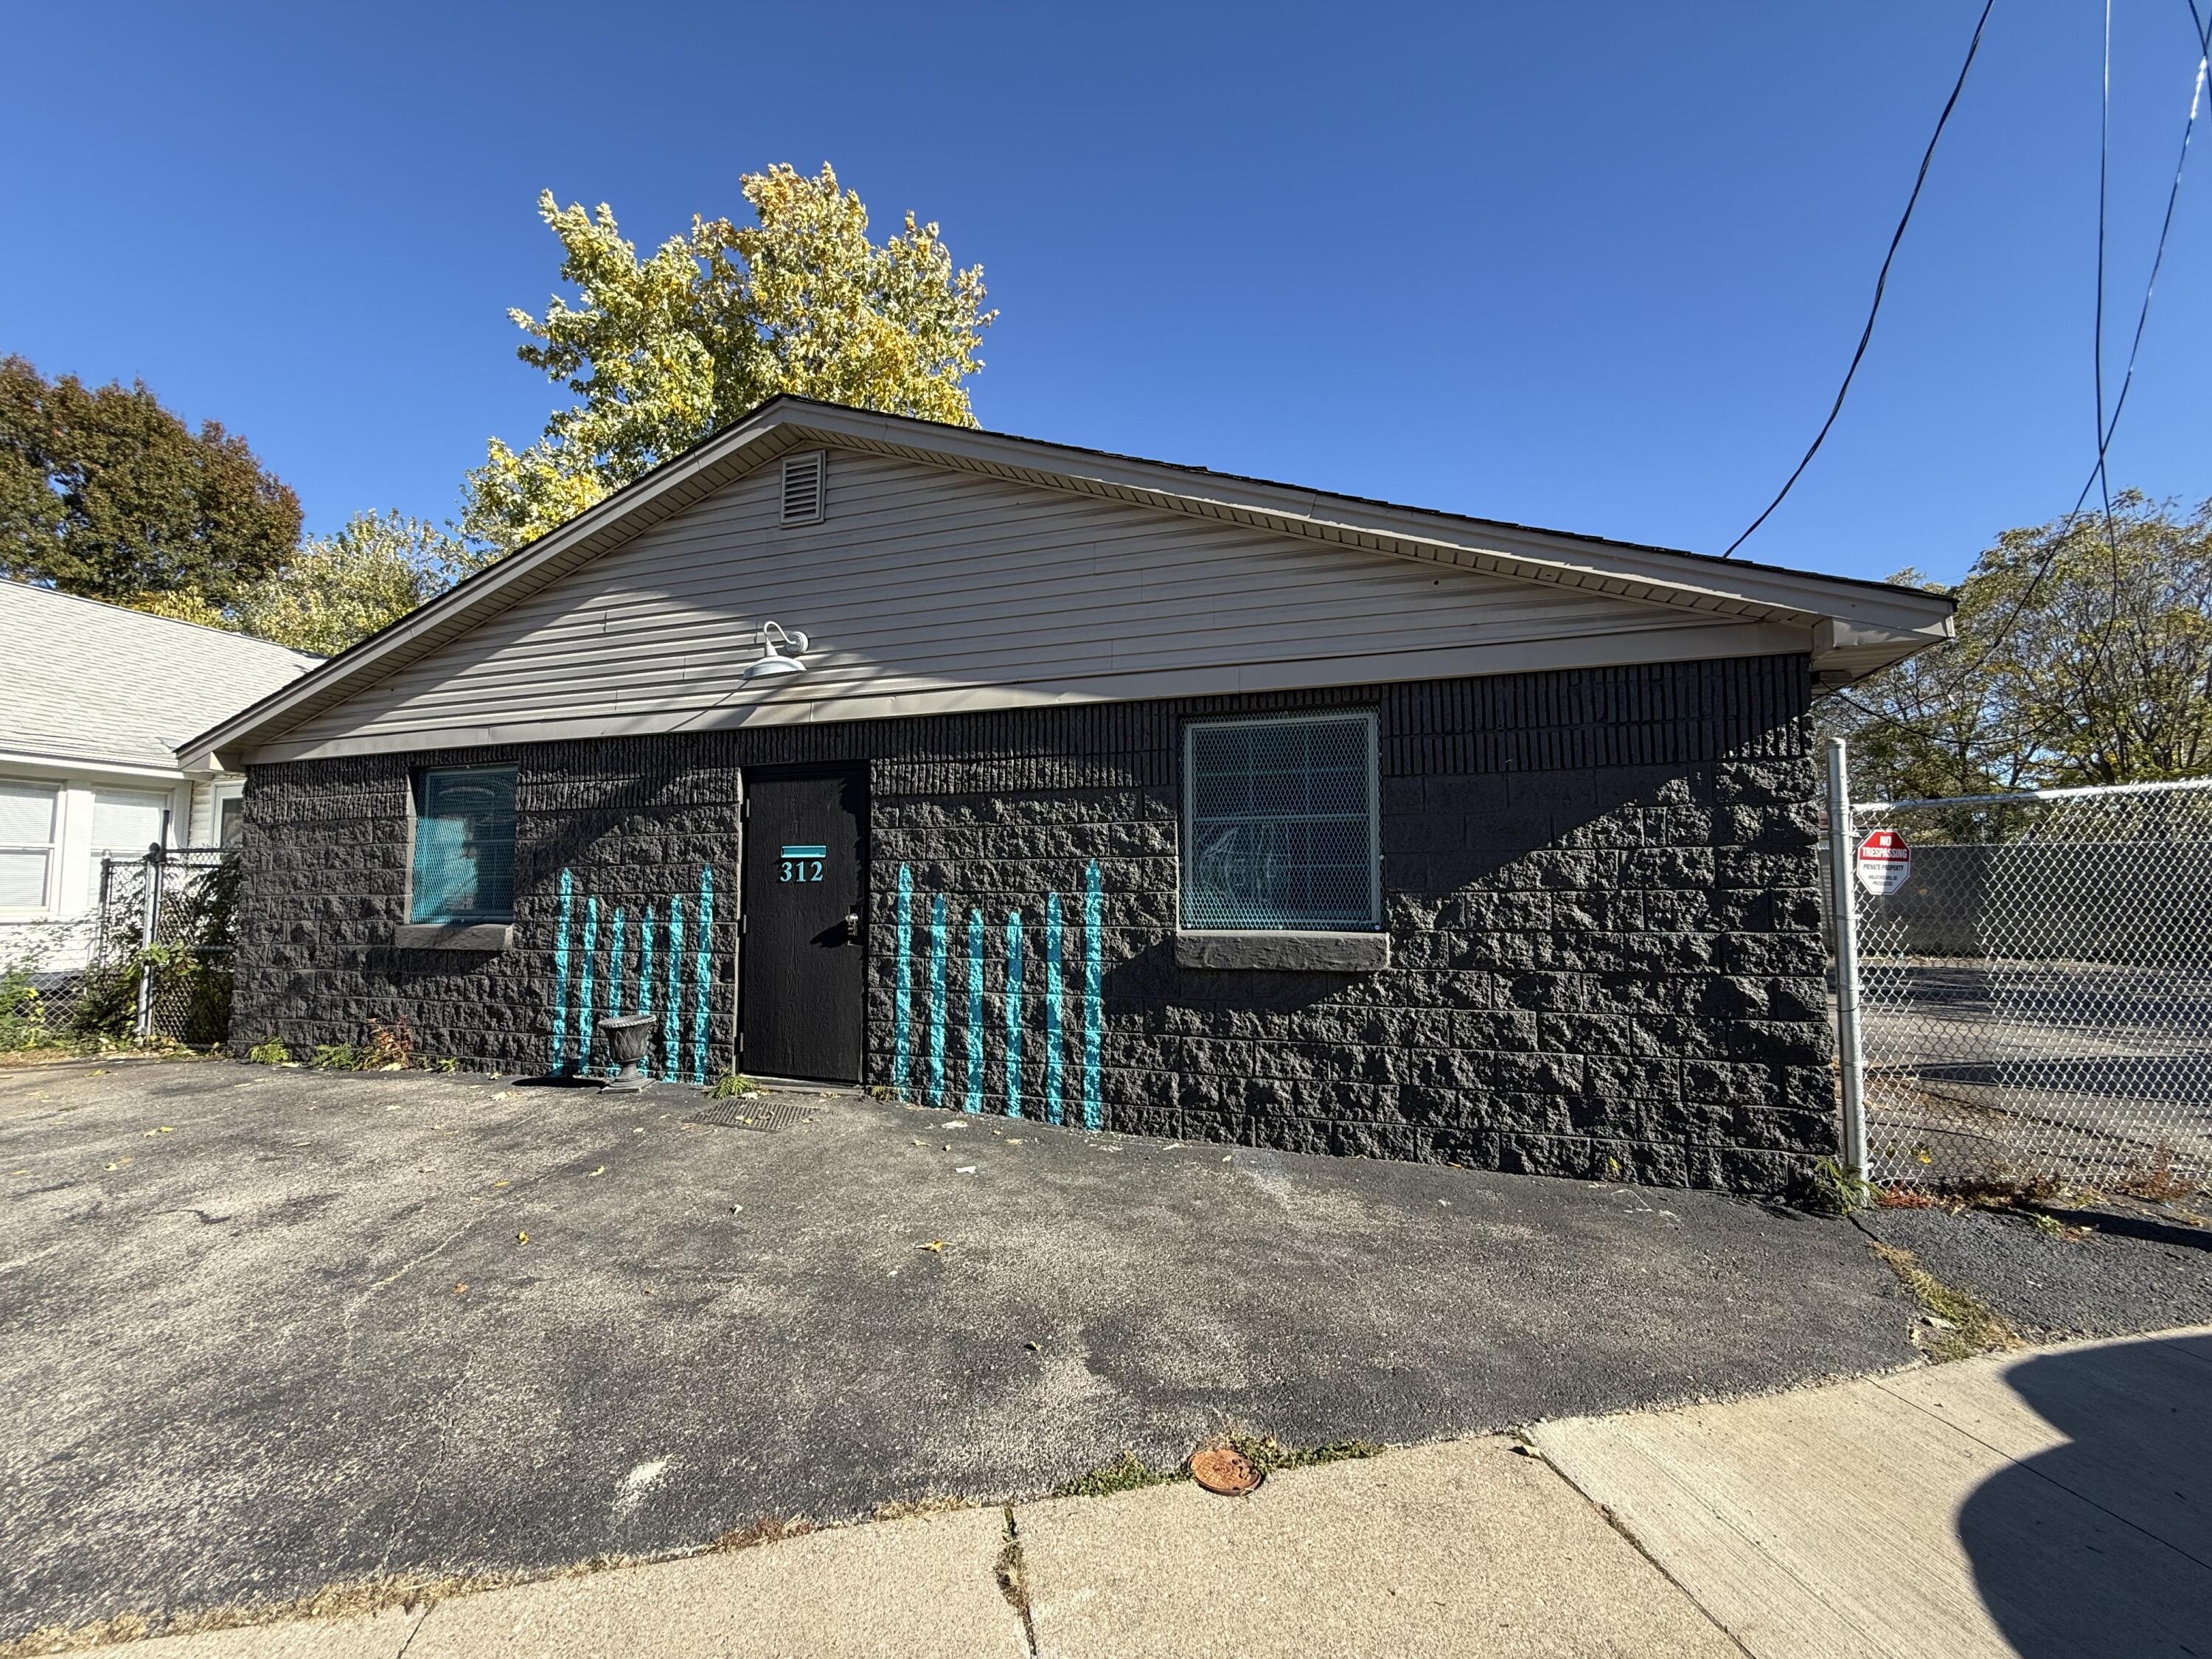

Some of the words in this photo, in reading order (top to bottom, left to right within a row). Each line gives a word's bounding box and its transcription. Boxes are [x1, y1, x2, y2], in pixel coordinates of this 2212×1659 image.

[1879, 835, 1891, 846] NO
[1862, 846, 1907, 858] TRESPASSING
[779, 860, 823, 882] 312
